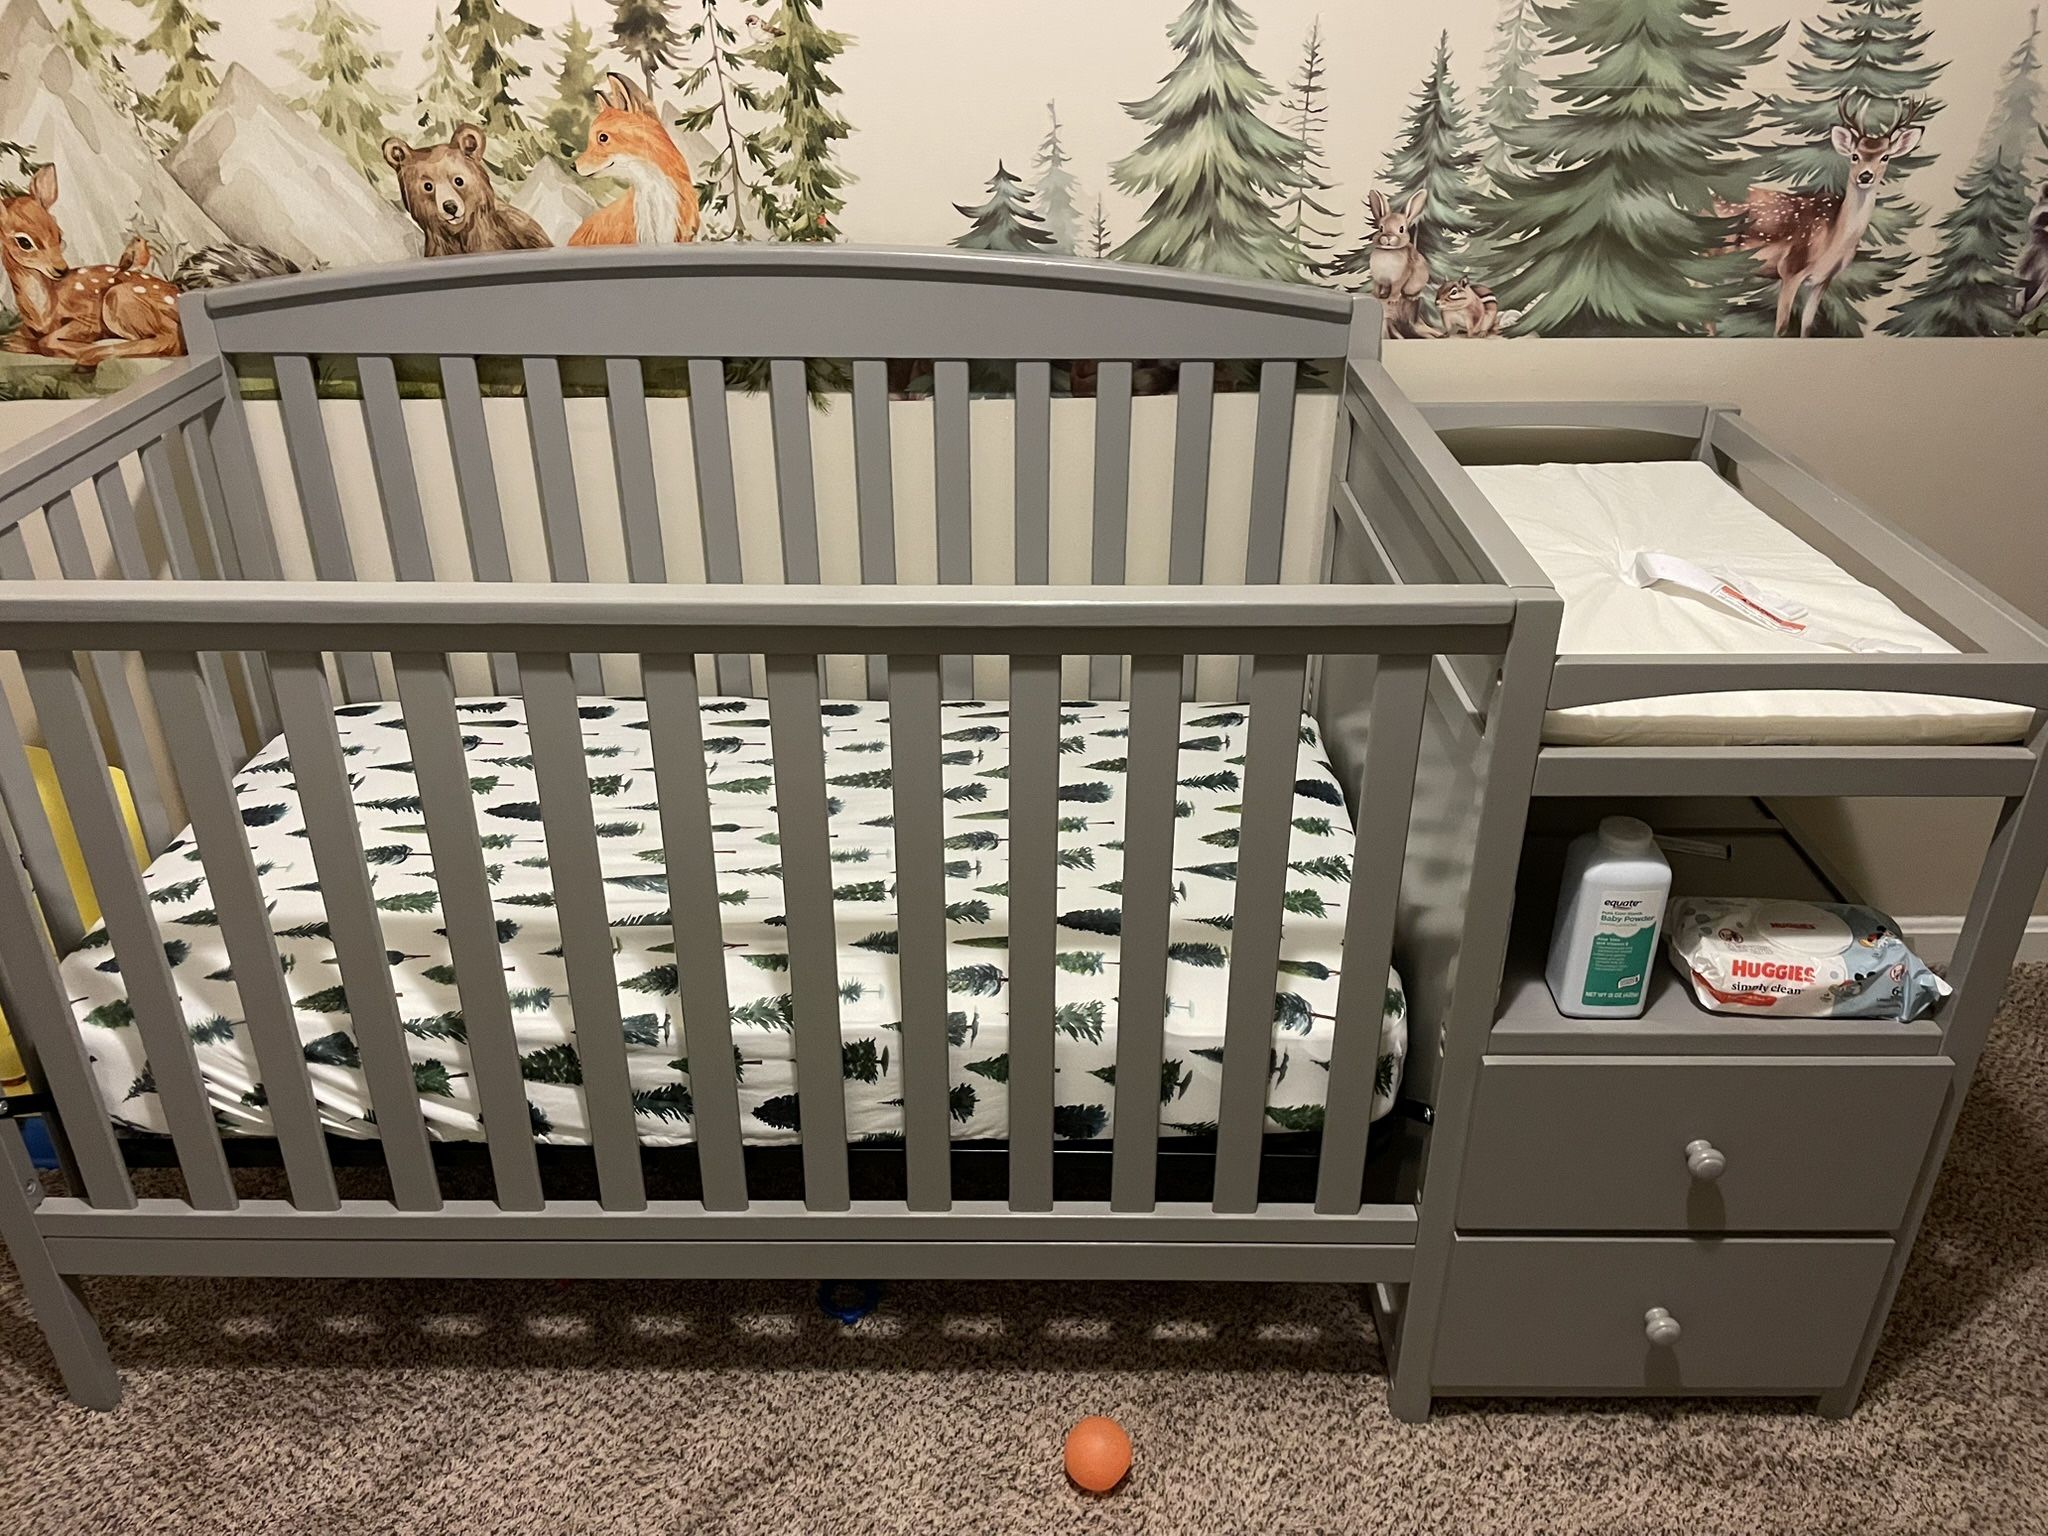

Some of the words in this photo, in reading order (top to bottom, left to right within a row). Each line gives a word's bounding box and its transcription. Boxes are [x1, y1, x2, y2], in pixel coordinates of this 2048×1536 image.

[1604, 899, 1642, 908] equate
[1601, 914, 1622, 923] Baby
[1731, 959, 1816, 984] HUGGIES
[1770, 985, 1801, 995] clean
